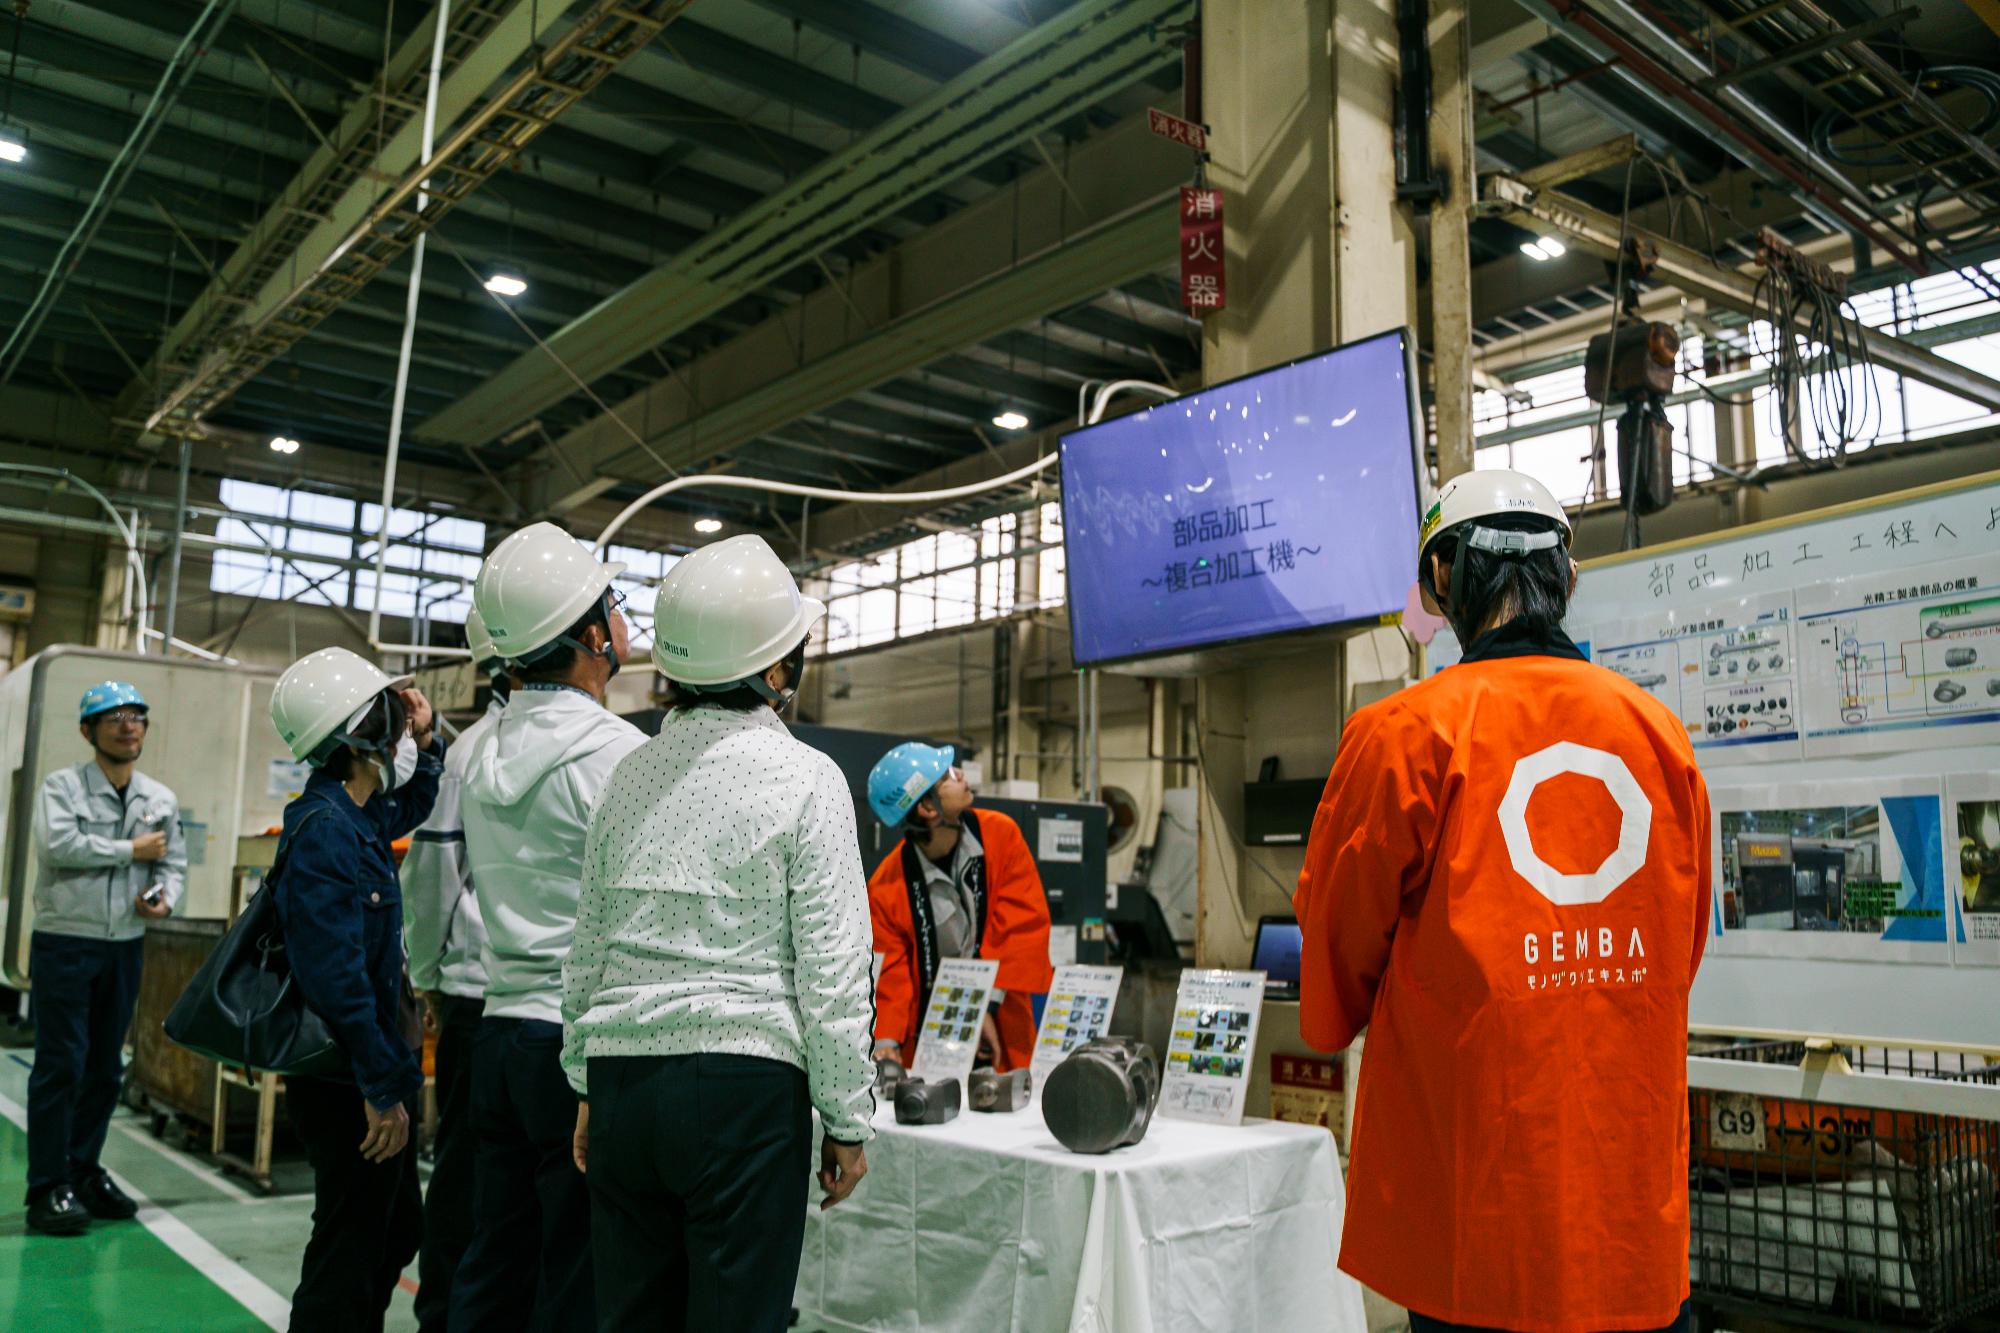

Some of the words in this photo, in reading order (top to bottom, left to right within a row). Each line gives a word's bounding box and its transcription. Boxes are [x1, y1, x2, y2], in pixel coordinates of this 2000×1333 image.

[1153, 113, 1202, 148] 消火器
[1187, 191, 1219, 306] 消火器
[1173, 499, 1277, 549] 部品加工
[1524, 927, 1645, 964] GEMBA
[1718, 1111, 1756, 1135] G9
